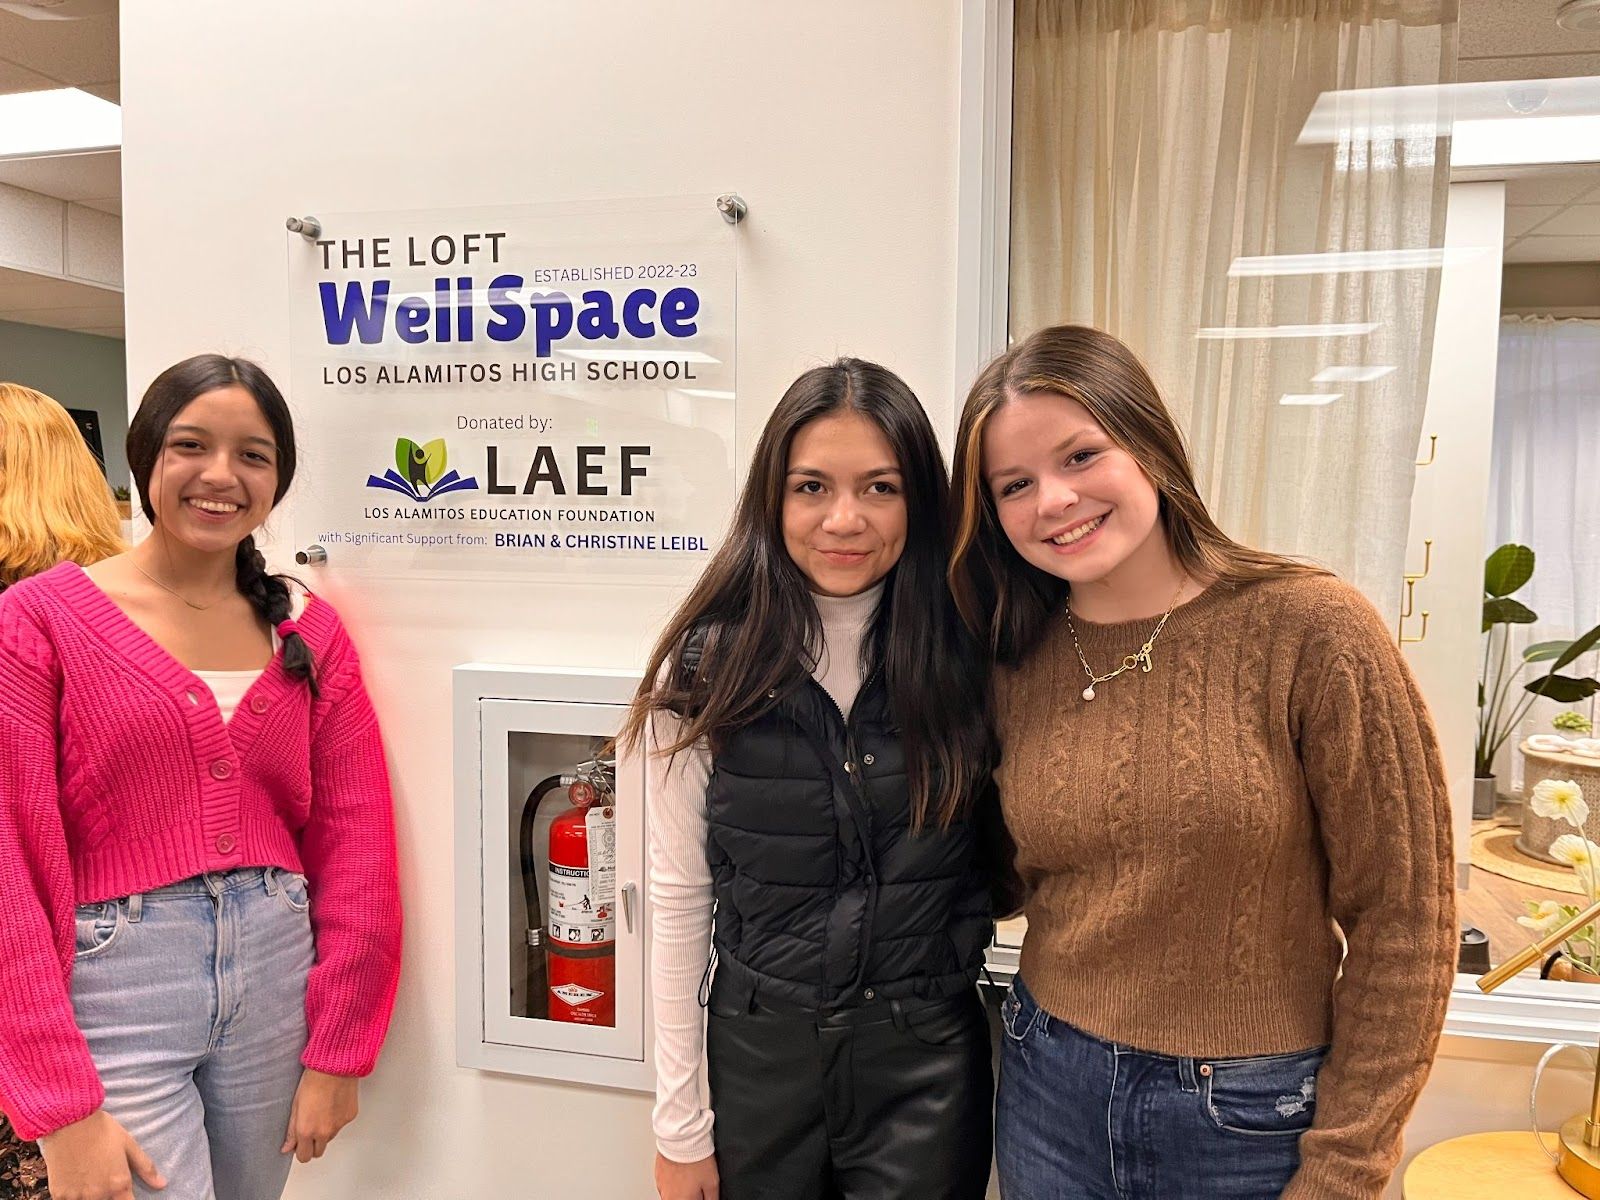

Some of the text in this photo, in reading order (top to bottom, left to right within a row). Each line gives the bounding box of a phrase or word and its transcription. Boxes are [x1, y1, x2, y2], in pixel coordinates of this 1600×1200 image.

[316, 233, 505, 269] THE LOFT
[535, 264, 696, 282] ESTABLISHED 2022-23
[324, 361, 696, 384] LOS ALAMITOS HIGH SCHOOL
[458, 415, 552, 431] Donated by:
[487, 446, 650, 495] LAEF
[365, 508, 654, 522] LOS ALAMITOS EDUCATION FOUNDATION
[318, 532, 708, 550] with Significant Support from: BRIAN & CHRISTINE LEIBL
